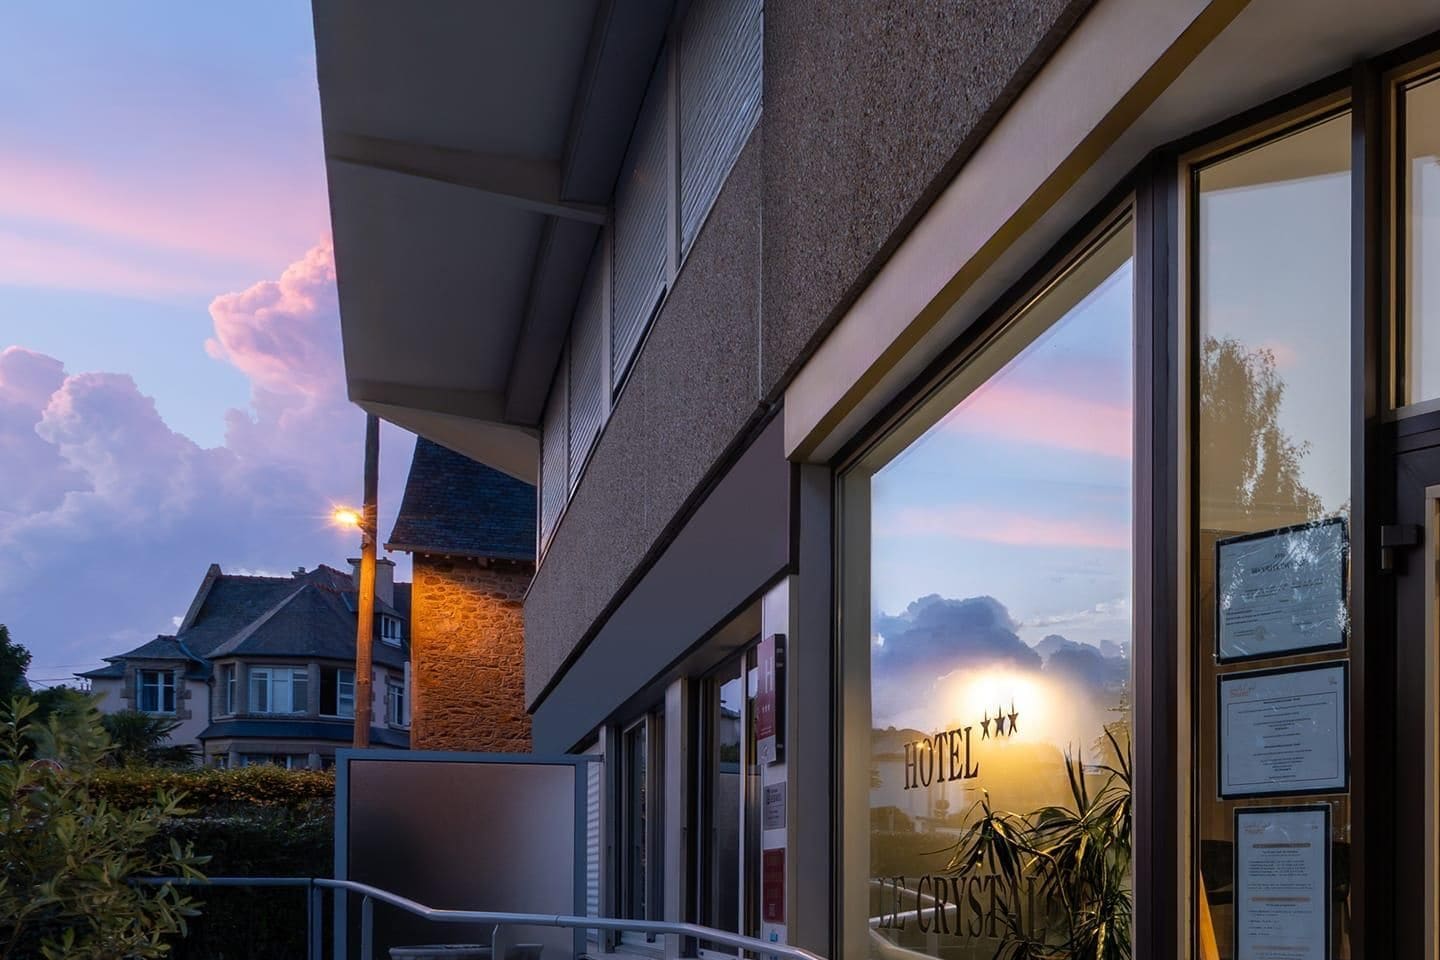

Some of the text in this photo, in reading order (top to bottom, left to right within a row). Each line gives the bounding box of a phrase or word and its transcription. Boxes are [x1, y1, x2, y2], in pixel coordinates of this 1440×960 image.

[903, 727, 979, 790] HOTEL
[878, 874, 1047, 945] LE CRYSTAL
